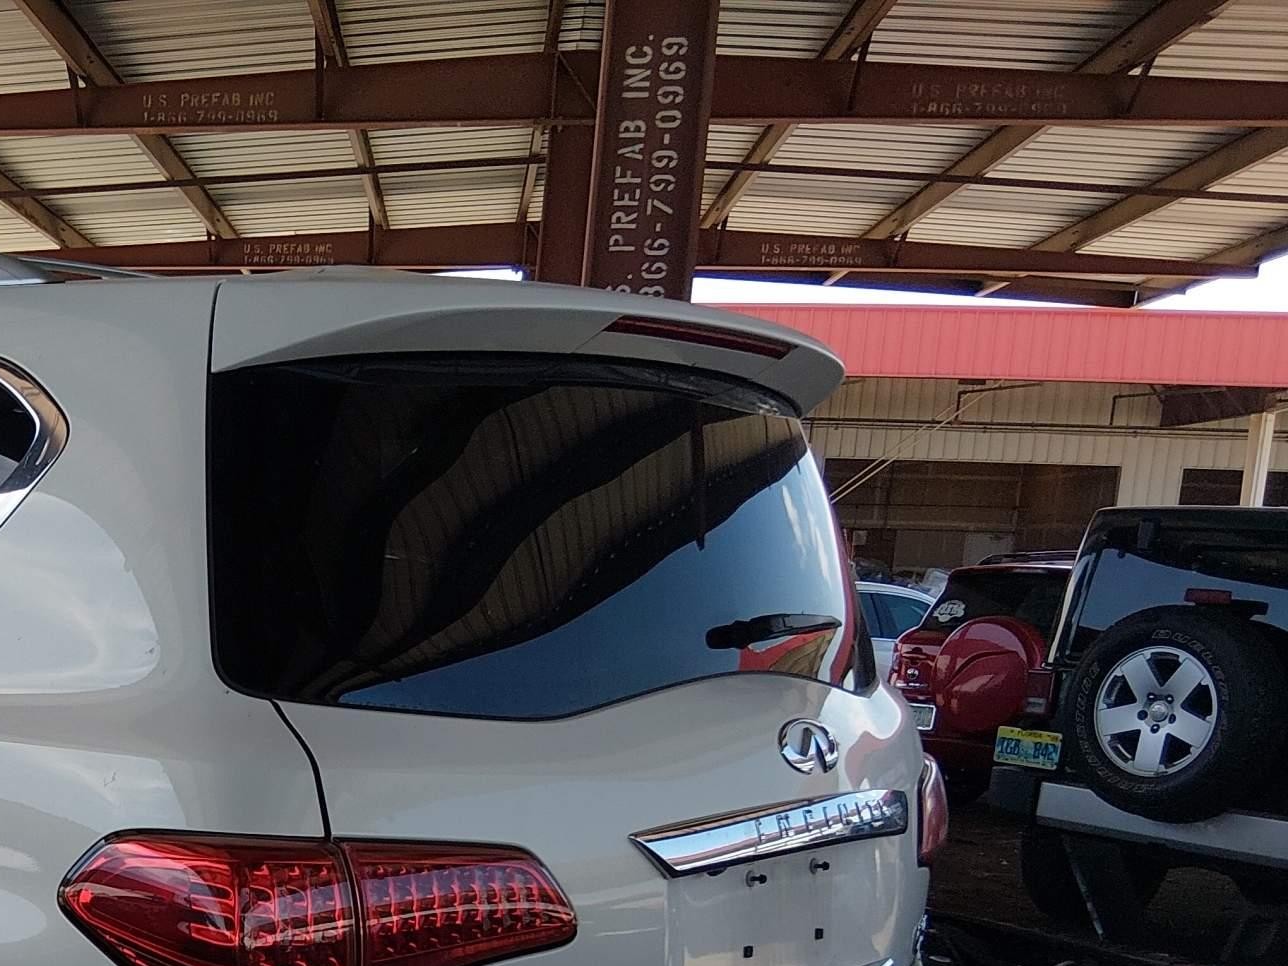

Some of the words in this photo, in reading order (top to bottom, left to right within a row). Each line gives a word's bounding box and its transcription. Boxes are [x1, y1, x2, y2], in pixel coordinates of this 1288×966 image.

[622, 34, 654, 99] INC.
[180, 92, 241, 107] PREFAB
[249, 92, 275, 107] INC
[609, 119, 647, 252] PREFAB
[269, 243, 311, 254] PREFAB
[790, 243, 836, 255] PREFAB
